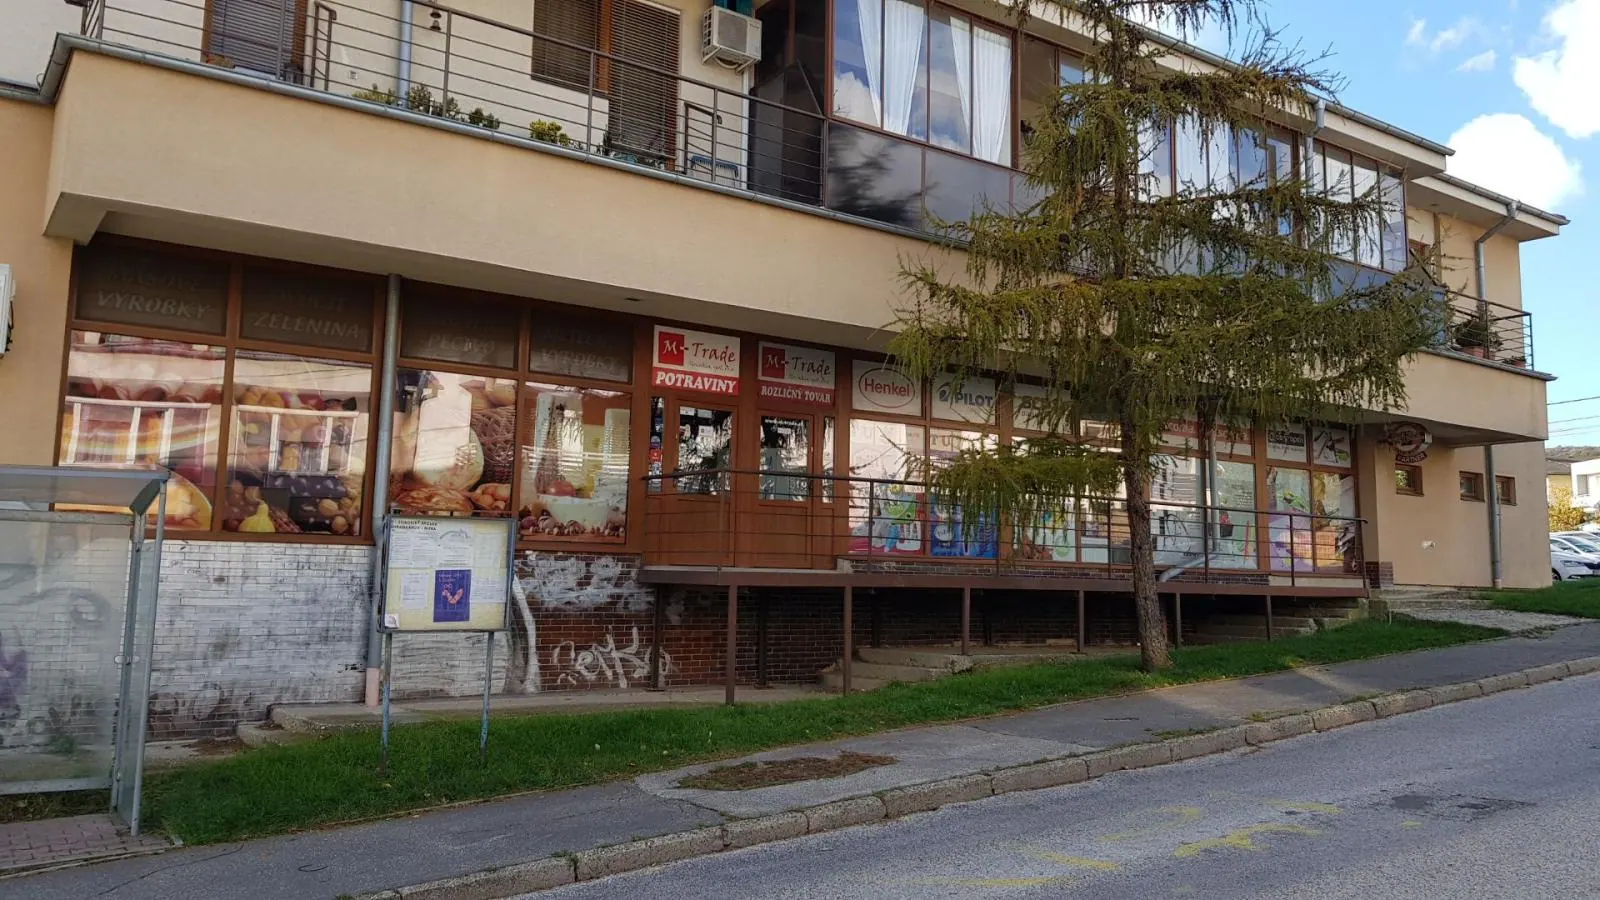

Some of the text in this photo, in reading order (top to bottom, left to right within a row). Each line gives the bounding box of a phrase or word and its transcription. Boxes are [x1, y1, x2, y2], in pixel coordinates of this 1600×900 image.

[252, 311, 360, 340] ZELENINA
[655, 371, 736, 393] POTRAVINY
[864, 378, 910, 397] Henkel
[804, 391, 832, 404] TOVAR
[955, 394, 993, 408] PILOT
